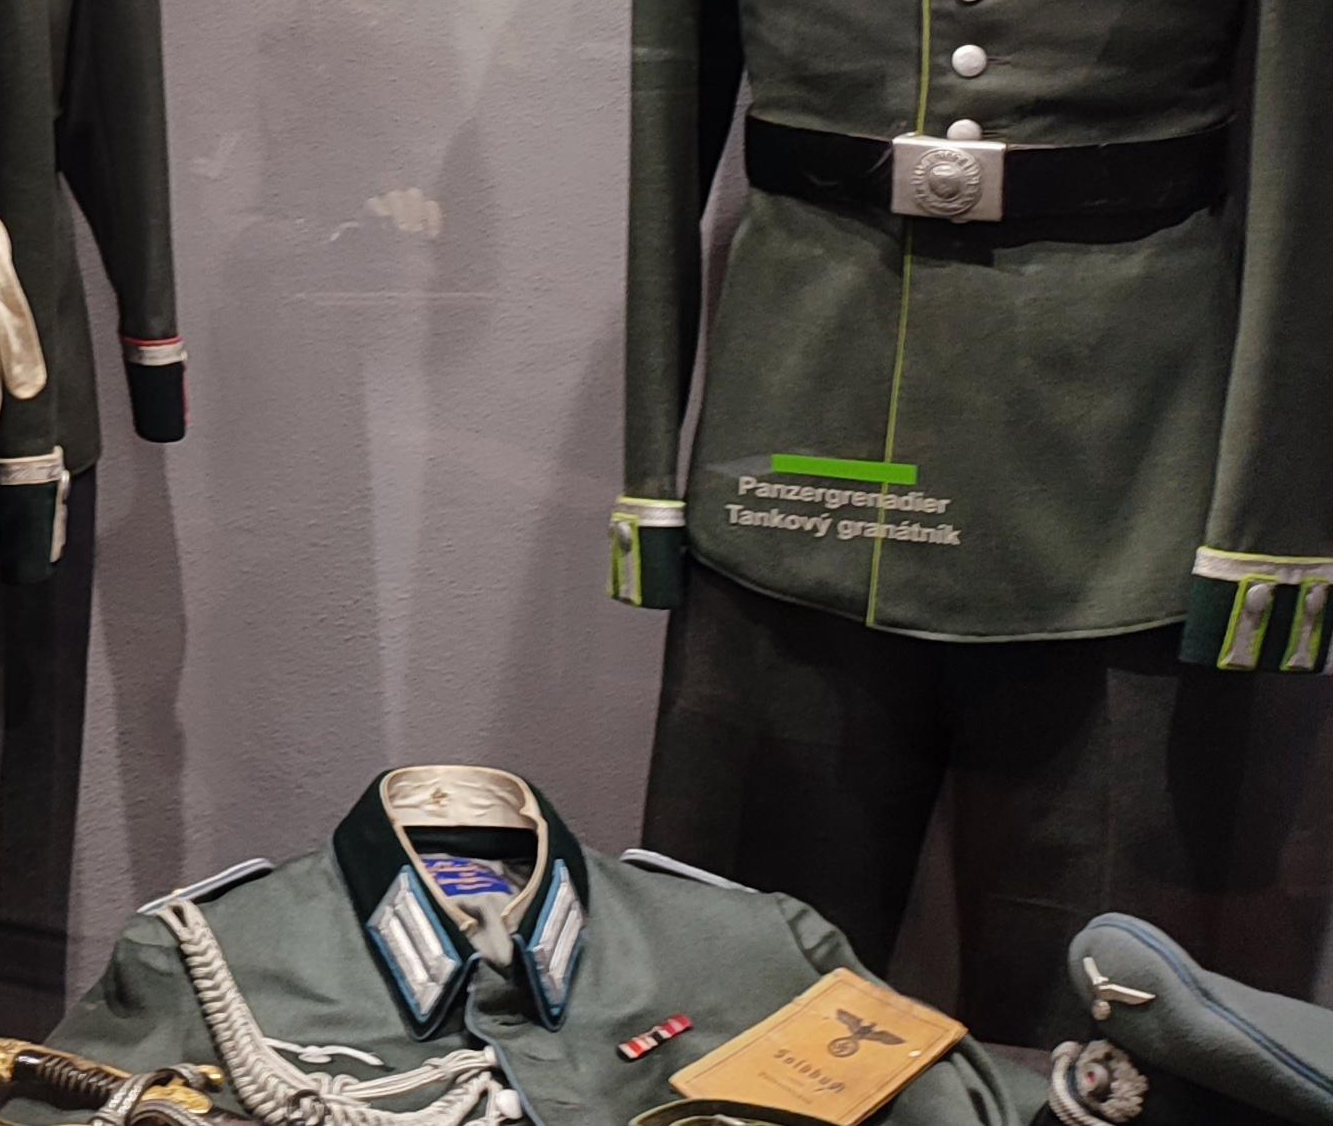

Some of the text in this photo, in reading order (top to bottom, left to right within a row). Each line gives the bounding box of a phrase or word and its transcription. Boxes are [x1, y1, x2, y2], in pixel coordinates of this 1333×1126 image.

[738, 475, 952, 514] Panzergrenadier
[725, 504, 963, 546] Tankový granátník
